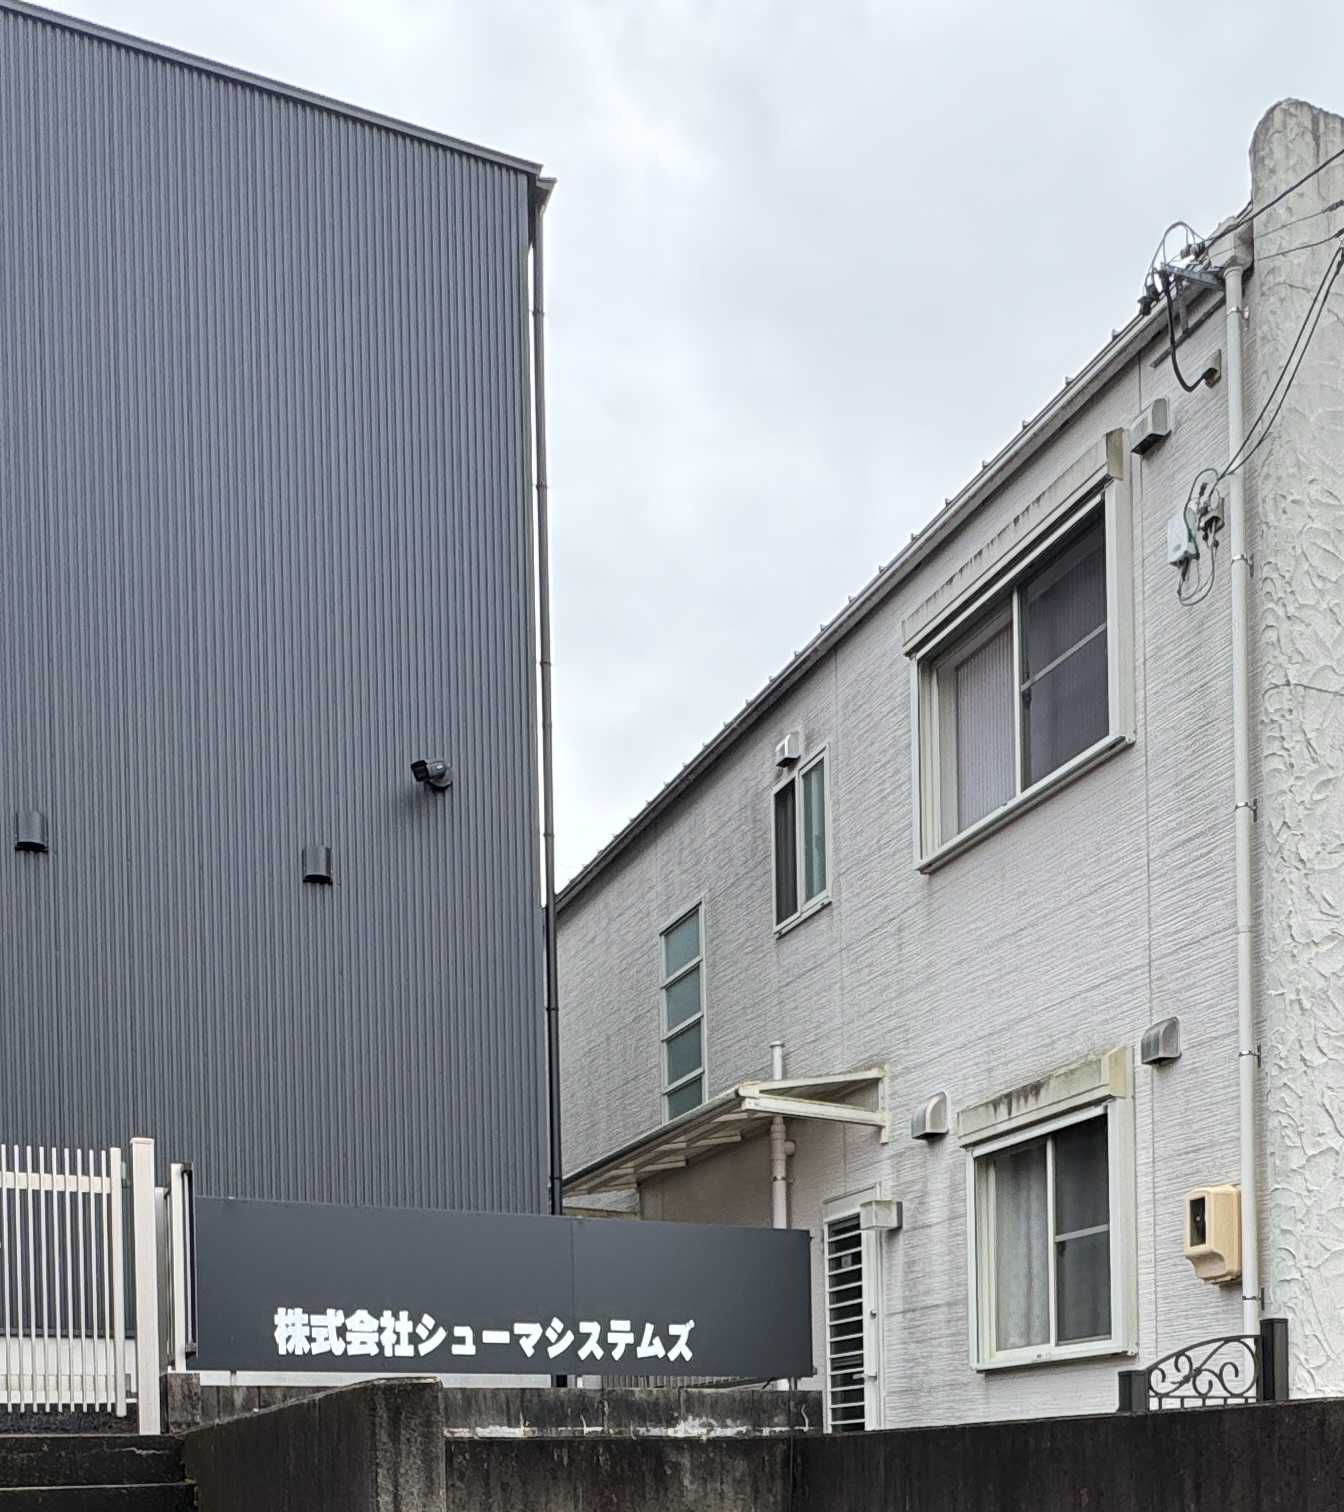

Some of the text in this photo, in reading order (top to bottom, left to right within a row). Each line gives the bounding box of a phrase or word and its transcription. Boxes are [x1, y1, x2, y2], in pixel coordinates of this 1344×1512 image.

[273, 1306, 696, 1362] 株式会社シューマシステムズ
